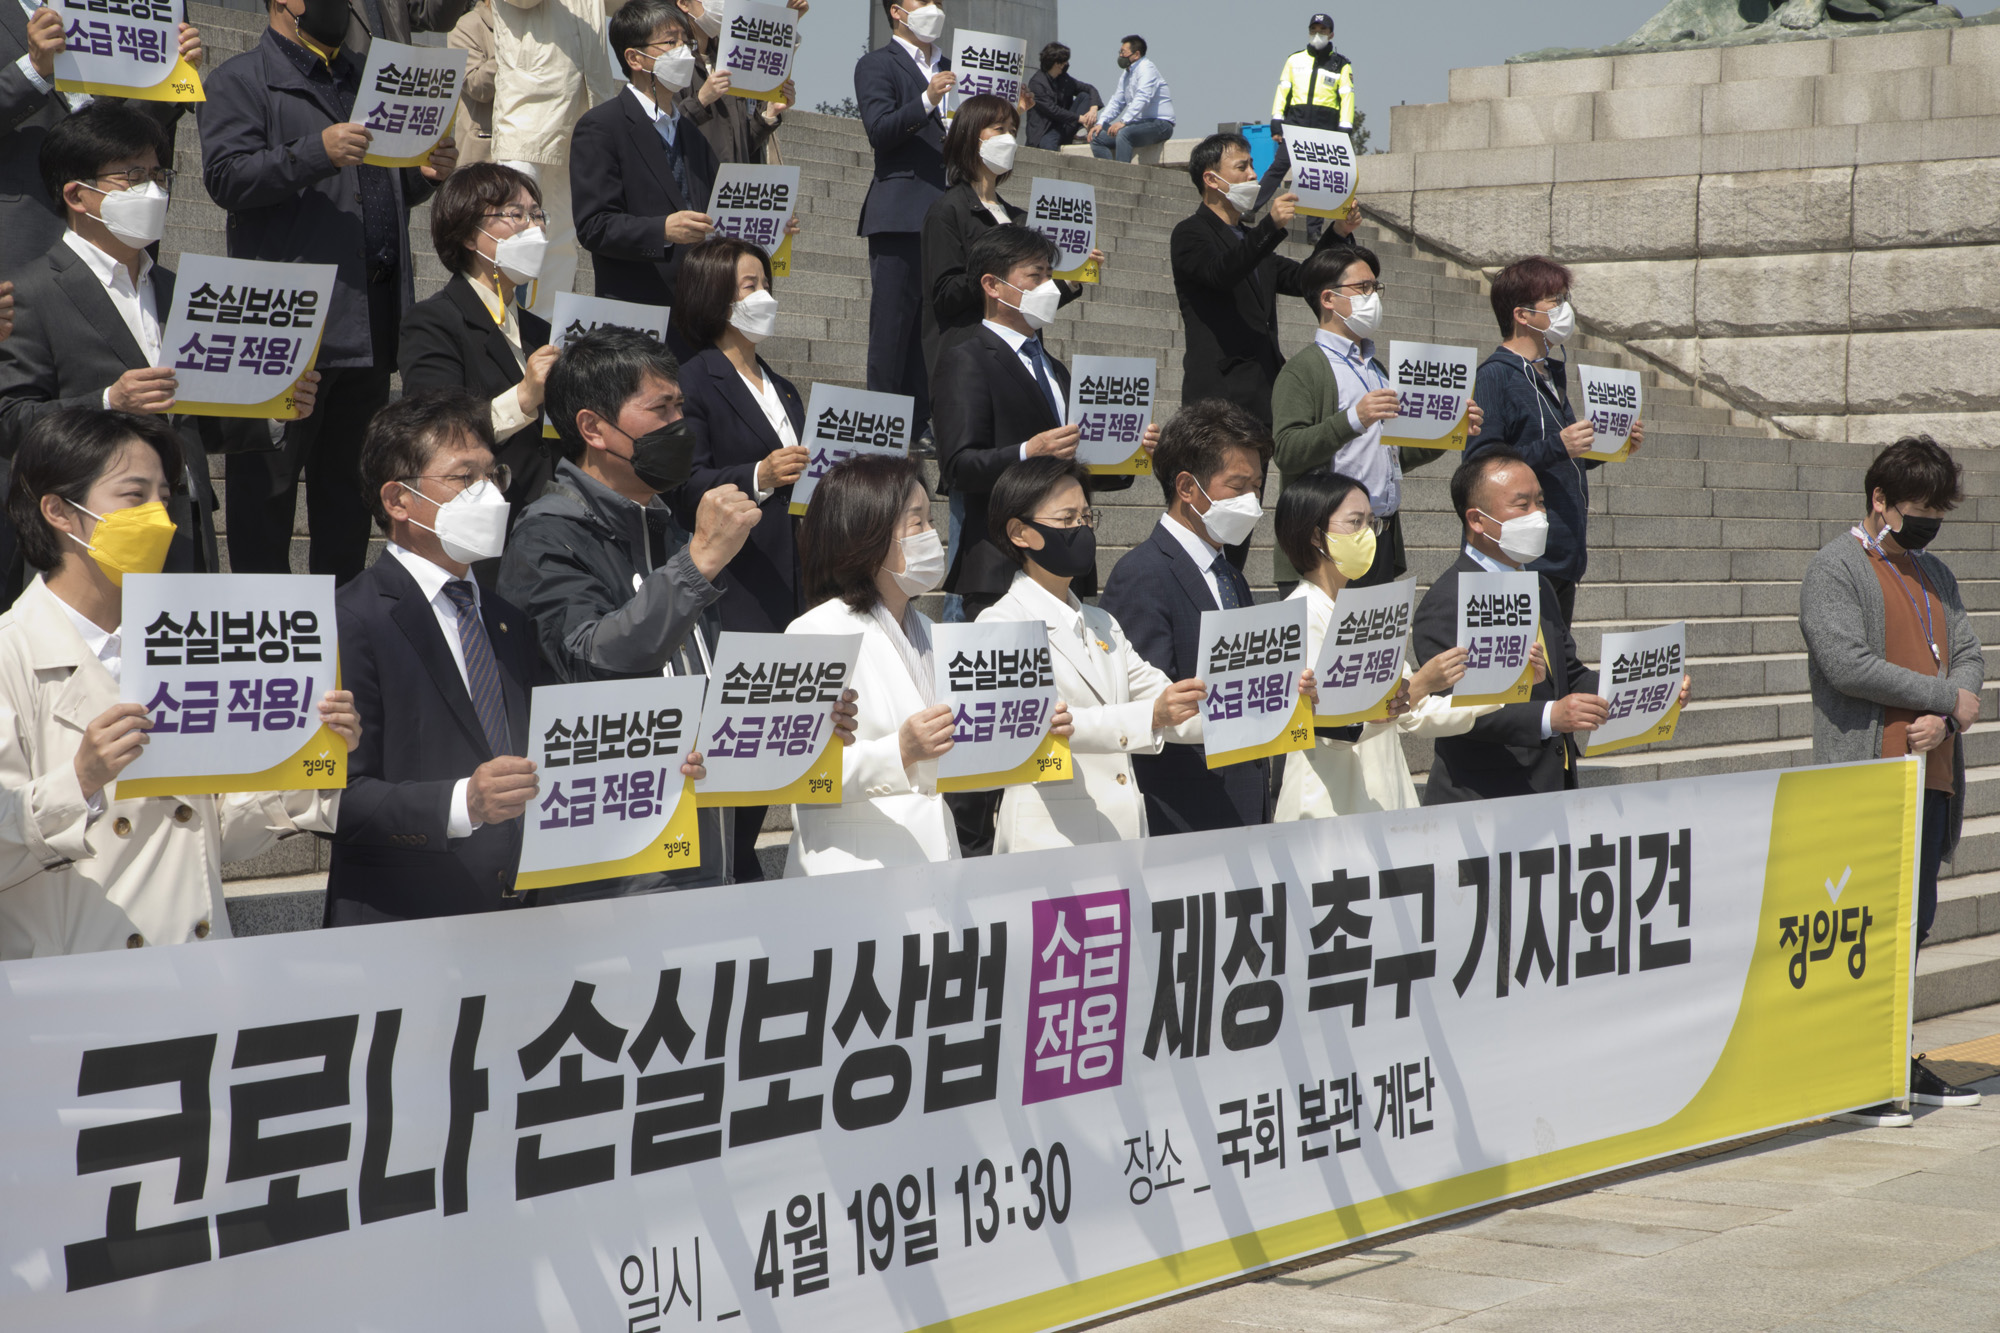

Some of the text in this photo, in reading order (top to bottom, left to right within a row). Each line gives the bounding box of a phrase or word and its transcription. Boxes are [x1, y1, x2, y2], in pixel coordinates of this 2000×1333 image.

[65, 19, 167, 64] 소급 적용!
[731, 15, 793, 48] 손실보상은
[727, 45, 788, 77] 소급 적용!
[961, 45, 1024, 76] 손실보상은
[375, 62, 457, 99] 손실보상은
[958, 73, 993, 96] 소급
[364, 101, 445, 137] 소급 적용!
[1292, 139, 1351, 167] 손실보상은
[716, 181, 789, 212] 손실보상은
[1298, 167, 1349, 194] 소급 적용!
[1035, 194, 1093, 225] 손실보상은
[743, 217, 780, 245] 적용!
[1059, 228, 1091, 254] 적용!
[186, 282, 319, 328] 손실보상은
[174, 332, 302, 376] 소급 적용!
[1078, 375, 1150, 407] 손실보상은
[1398, 358, 1468, 390] 손실보상은
[1397, 391, 1461, 421] 소급 적용!
[1587, 380, 1637, 409] 손실보상은
[816, 406, 905, 449] 손실보상은
[1078, 412, 1144, 443] 소급 적용!
[1590, 409, 1633, 437] 소급 적용!
[1335, 601, 1410, 647] 손실보상은
[1466, 593, 1532, 628] 손실보상은
[144, 609, 323, 666] 손실보상은
[1209, 623, 1301, 674] 손실보상은
[1464, 633, 1527, 669] 소급 적용!
[720, 660, 847, 705] 손실보상은
[948, 647, 1054, 692] 손실보상은
[1321, 645, 1401, 689] 소급 적용!
[1611, 643, 1681, 685] 손실보상은
[143, 676, 314, 734] 소급 적용!
[1204, 671, 1293, 721] 소급 적용!
[1607, 681, 1675, 721] 소급 적용!
[543, 707, 683, 769] 손실보상은
[706, 712, 826, 758] 소급 적용!
[951, 696, 1050, 743] 소급 적용!
[1290, 727, 1309, 743] 정의당
[302, 759, 337, 777] 정의당
[1036, 757, 1063, 772] 정의당
[539, 767, 667, 830] 소급 적용!
[808, 777, 833, 794] 정의당
[663, 841, 691, 859] 정의당
[1039, 903, 1124, 994] 소급
[1141, 827, 1692, 1062] 제정 촉구 기자회견
[1778, 904, 1874, 990] 정의당
[1034, 993, 1118, 1085] 적용
[64, 921, 1008, 1293] 코로나 손실보상법
[1123, 1128, 1185, 1205] 장소
[1217, 1088, 1286, 1179] 국회
[1297, 1072, 1363, 1163] 본관
[1373, 1055, 1436, 1141] 계단
[754, 1192, 830, 1299] 4월
[846, 1167, 939, 1275] 19일
[954, 1141, 1072, 1247] 13:30
